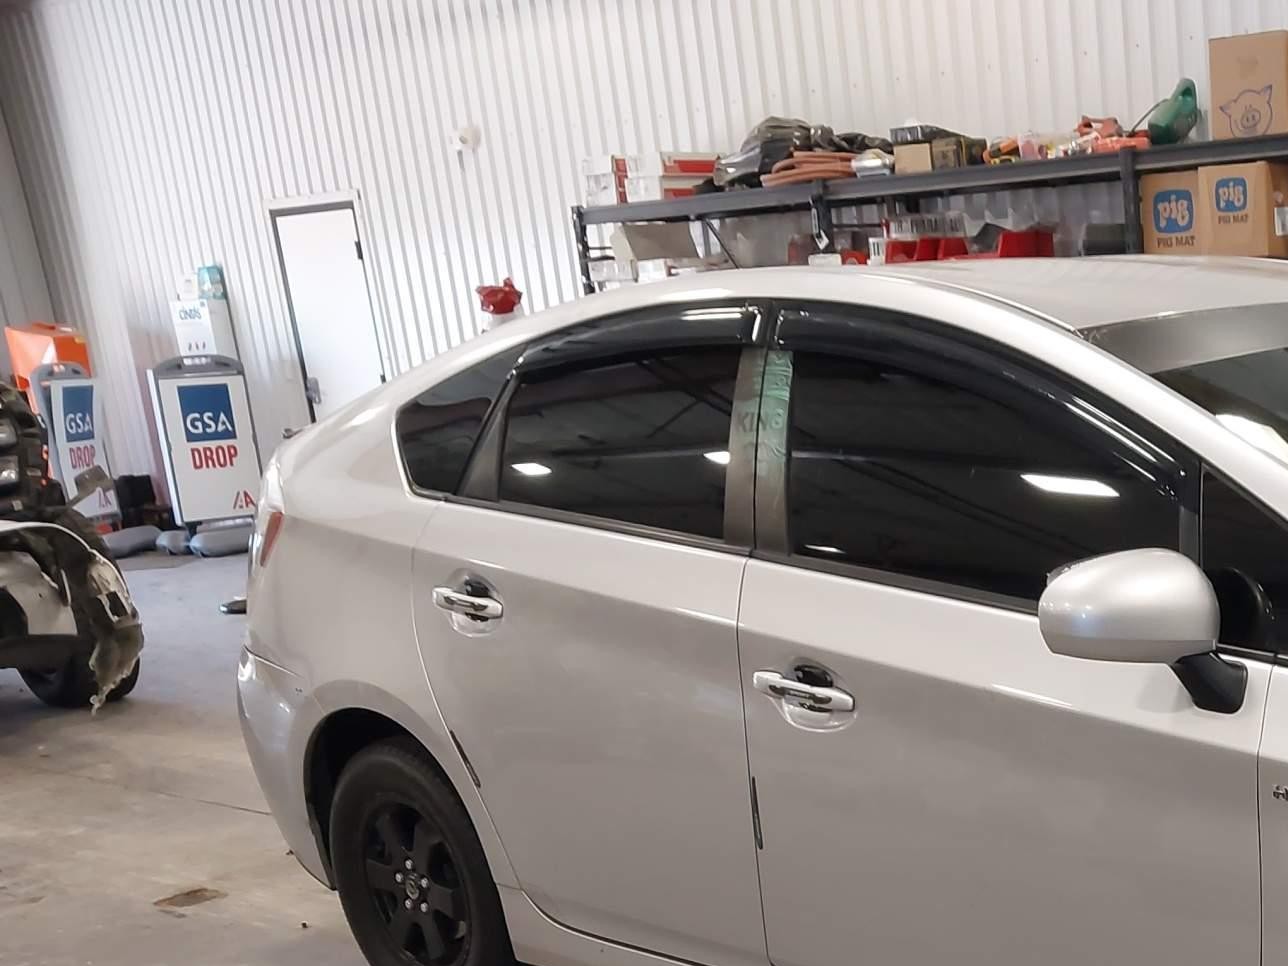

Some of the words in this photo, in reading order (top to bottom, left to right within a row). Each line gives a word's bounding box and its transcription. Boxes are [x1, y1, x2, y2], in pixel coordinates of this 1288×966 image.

[1218, 181, 1244, 209] pig
[1157, 194, 1190, 229] pig
[1218, 214, 1231, 225] PIG
[1233, 213, 1248, 224] MAT
[1157, 237, 1173, 248] PIG
[1175, 235, 1196, 247] MAT
[66, 413, 93, 434] GSA
[186, 412, 233, 434] GSA
[69, 445, 96, 469] DROP
[191, 445, 238, 470] DROP
